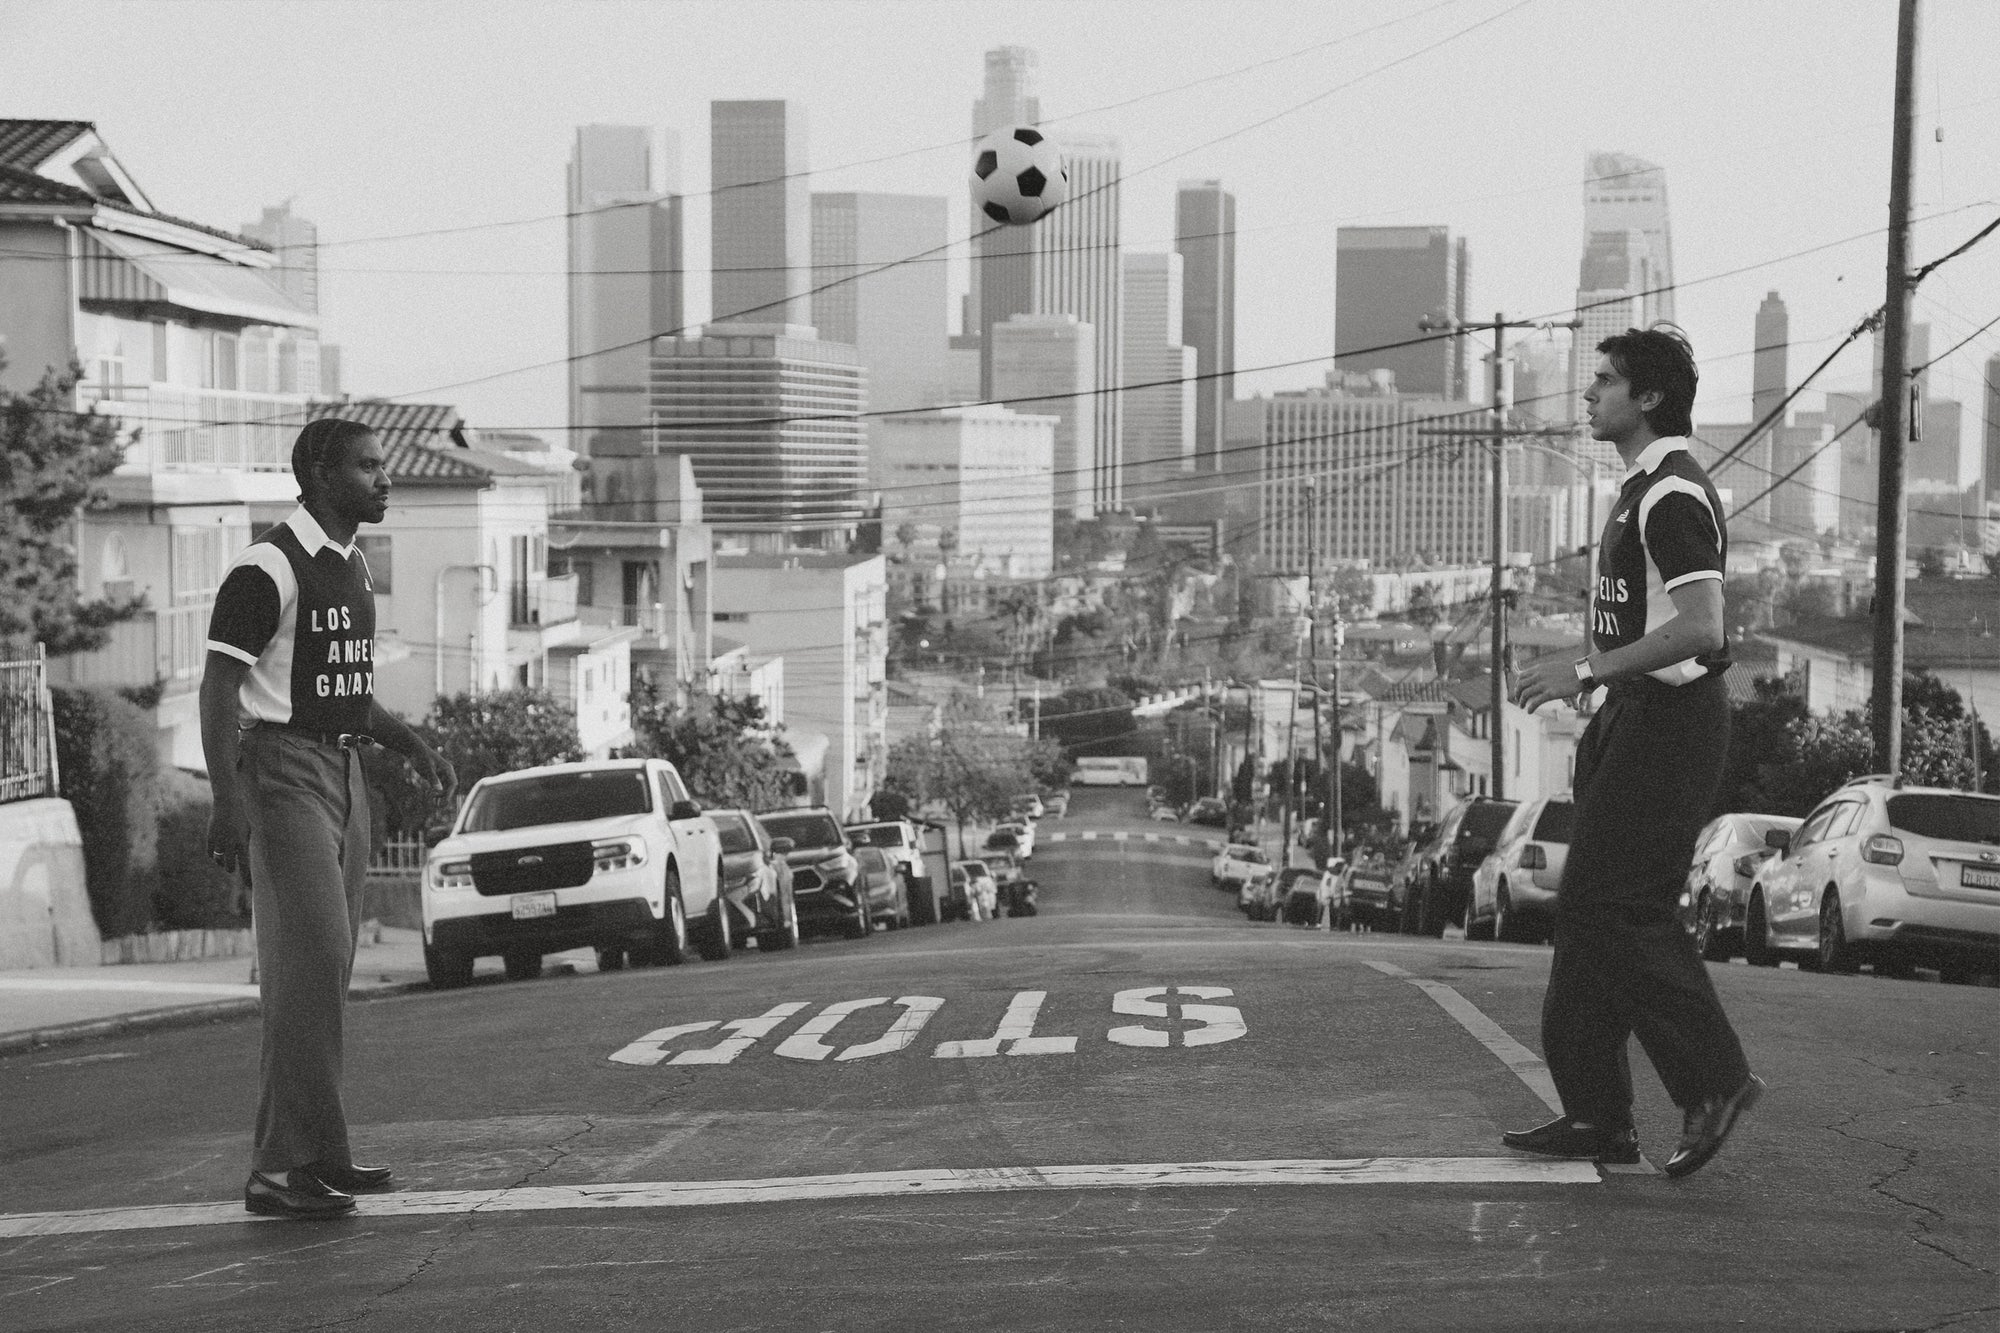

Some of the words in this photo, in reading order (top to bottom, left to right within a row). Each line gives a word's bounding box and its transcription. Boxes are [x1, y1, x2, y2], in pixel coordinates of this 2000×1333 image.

[312, 606, 351, 632] LOS
[1966, 872, 2000, 887] 7LRS12
[608, 985, 1248, 1066] STOP
